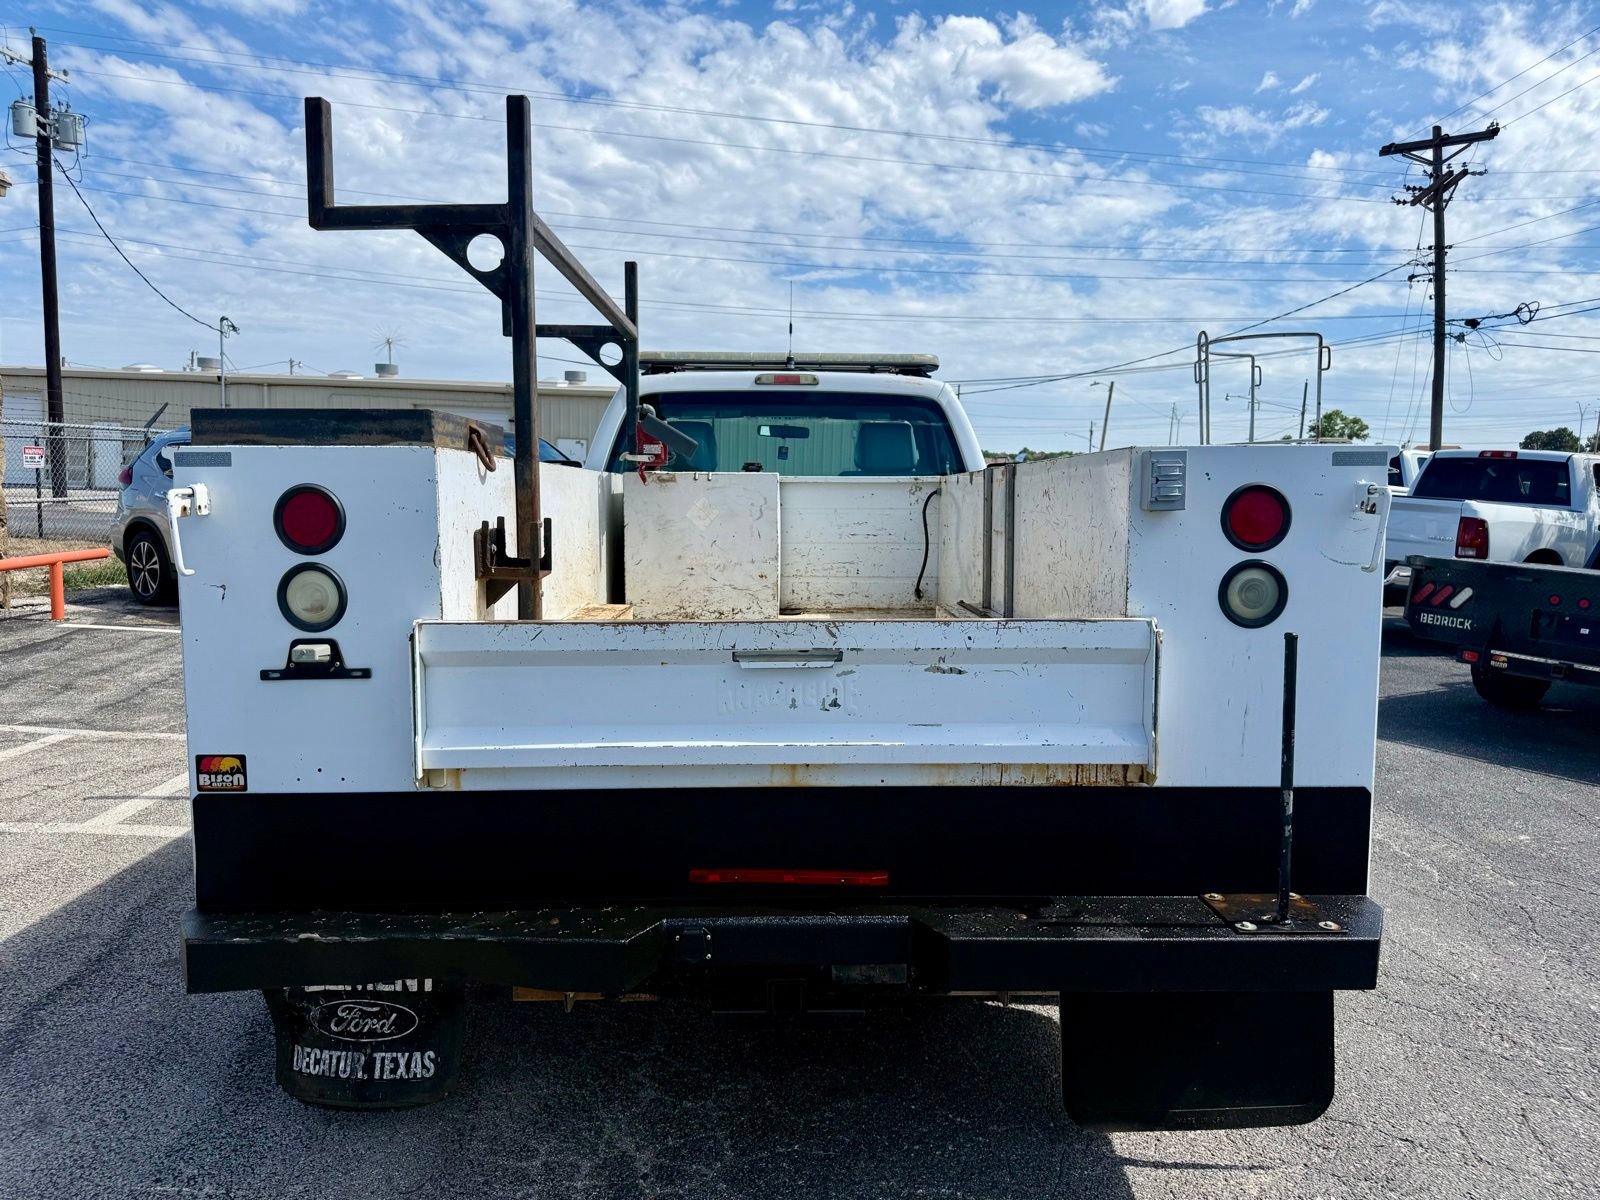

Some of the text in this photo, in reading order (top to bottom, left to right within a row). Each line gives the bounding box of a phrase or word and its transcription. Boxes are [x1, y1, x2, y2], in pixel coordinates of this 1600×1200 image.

[1420, 612, 1472, 630] BEDROCK
[330, 1004, 398, 1034] Ford
[373, 1050, 435, 1080] TEXAS
